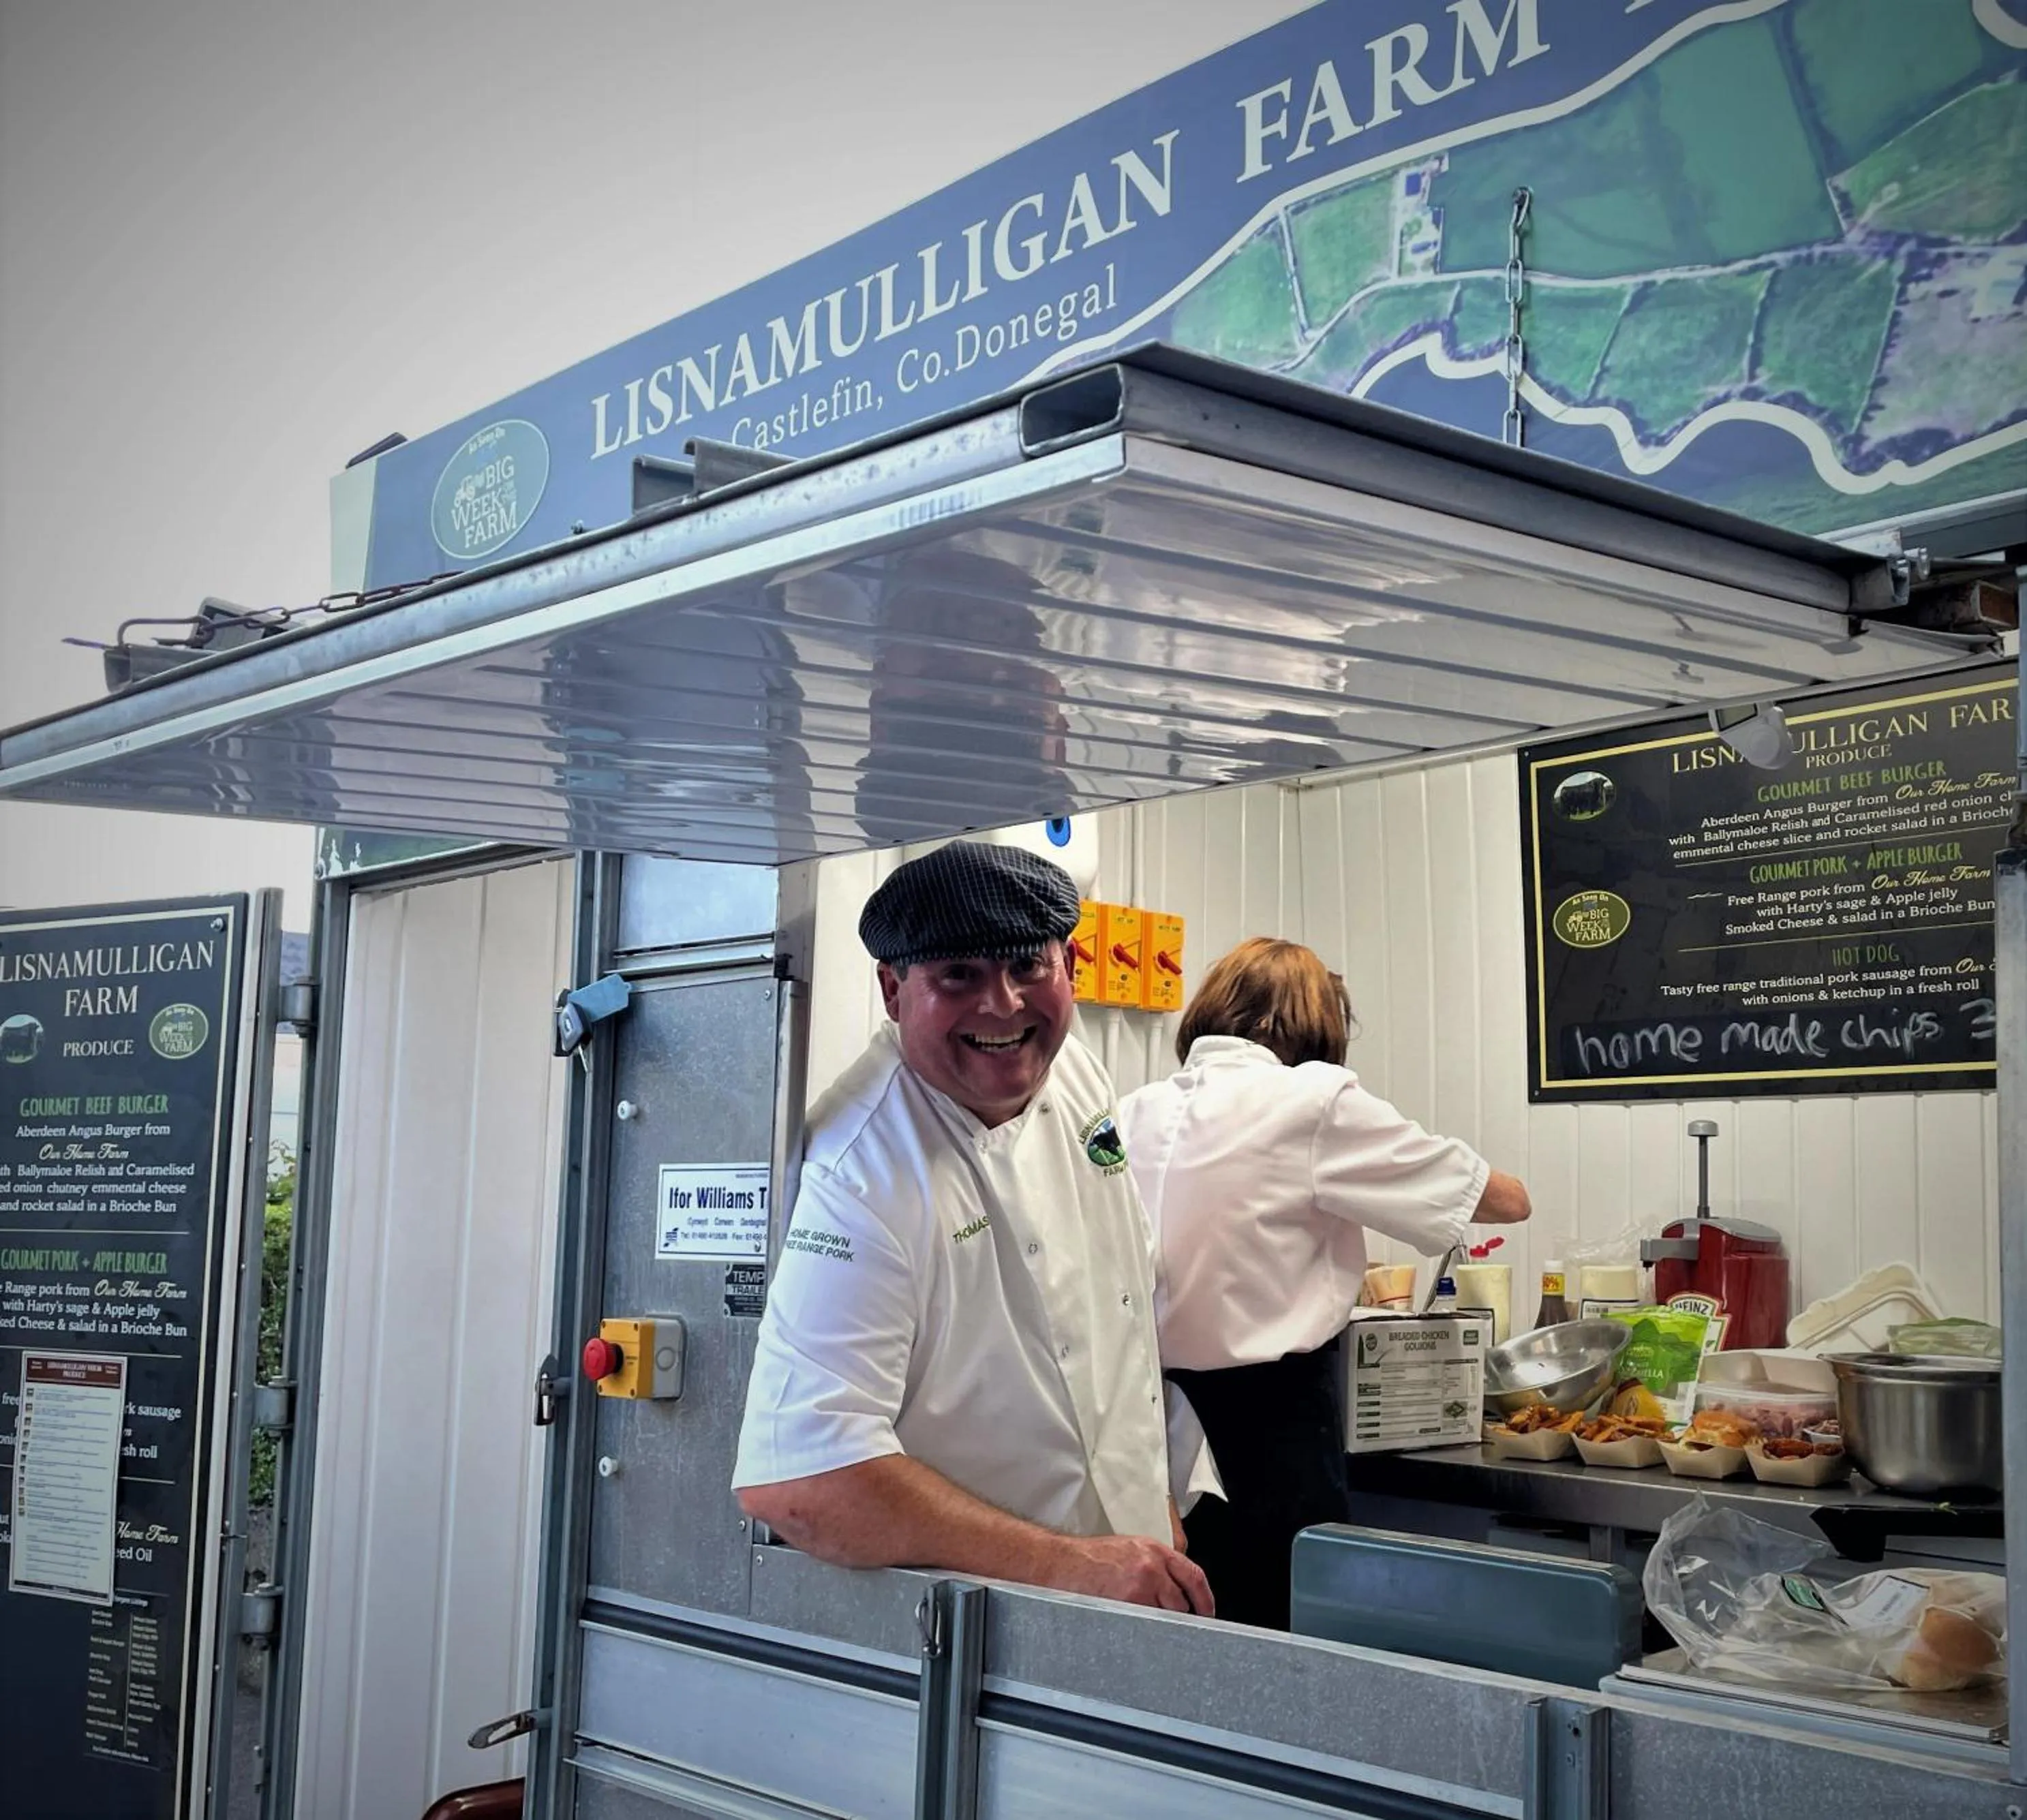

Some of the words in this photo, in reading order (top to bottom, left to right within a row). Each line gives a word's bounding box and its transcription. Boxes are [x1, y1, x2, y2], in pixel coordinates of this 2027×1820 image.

[589, 129, 1180, 459] LISNAMULLIGAN
[1235, 0, 1551, 183] FARM
[732, 377, 883, 450] Castlefin,
[485, 455, 515, 489] BIG
[451, 488, 503, 531] WEEK
[465, 501, 517, 549] FARM
[1949, 698, 2015, 728] FAR
[1806, 743, 1892, 769] PRODUCE
[1758, 776, 1831, 803] GOURMET
[1840, 770, 1874, 790] BEEF
[1881, 760, 1947, 784] BURGER
[1701, 812, 1760, 828] Aberdeen
[1763, 805, 1803, 820] Angus
[1808, 799, 1853, 813] Burger
[1857, 794, 1889, 807] from
[1895, 784, 1925, 800] Our
[1928, 778, 1970, 796] Home
[1975, 772, 2016, 788] Farm
[1668, 833, 1696, 846] with
[1704, 824, 1769, 842] Ballymaloe
[1772, 818, 1809, 833] Relish
[1811, 815, 1831, 827] and
[1834, 802, 1920, 824] Caramelised
[1924, 799, 1948, 812] red
[1951, 795, 1992, 809] onion
[1673, 842, 1735, 859] emmental
[1737, 837, 1780, 851] cheese
[1783, 831, 1812, 846] slice
[1816, 828, 1841, 841] and
[1844, 822, 1887, 837] rocket
[1891, 817, 1927, 831] salad
[1932, 815, 1946, 827] in
[1949, 815, 1957, 824] a
[1750, 860, 1810, 884] GOURMET
[1814, 855, 1848, 876] PORK
[1867, 848, 1906, 870] APPLE
[1908, 842, 1963, 865] BURGER
[1728, 895, 1754, 906] Free
[1758, 890, 1796, 904] Range
[1801, 886, 1831, 900] pork
[1833, 883, 1865, 895] from
[1872, 874, 1899, 890] Our
[1904, 869, 1945, 886] Home
[1949, 865, 1991, 882] Farm
[1589, 907, 1609, 919] BIG
[1756, 905, 1783, 917] with
[1787, 900, 1833, 914] Harty's
[1836, 898, 1866, 910] sage
[1870, 895, 1881, 906] &
[1886, 891, 1925, 906] Apple
[1929, 887, 1957, 902] jelly
[1566, 921, 1600, 933] WEEK
[1726, 921, 1774, 935] Smoked
[1778, 916, 1823, 929] Cheese
[1827, 914, 1838, 925] &
[1842, 910, 1877, 924] salad
[1881, 910, 1893, 919] in
[1898, 910, 1906, 919] a
[1910, 903, 1963, 917] Brioche
[1967, 899, 1996, 912] Bun
[1575, 927, 1611, 941] FARM
[0, 940, 215, 983] LISNAMULLIGAN
[1866, 944, 1900, 963] DOG
[1660, 985, 1694, 997] Tasty
[1696, 983, 1720, 993] free
[1722, 981, 1756, 992] range
[1759, 974, 1824, 988] traditional
[1828, 972, 1859, 985] pork
[1862, 966, 1915, 981] sausage
[1919, 965, 1952, 976] from
[1955, 957, 1985, 974] Our
[64, 985, 138, 1017] FARM
[1742, 994, 1769, 1006] with
[1772, 991, 1814, 1004] onions
[1818, 990, 1829, 1000] &
[1833, 986, 1885, 1000] ketchup
[1889, 985, 1902, 996] in
[1906, 986, 1915, 994] a
[1919, 981, 1952, 993] fresh
[1956, 978, 1979, 991] roll
[63, 1039, 134, 1057] PRODUCE
[1575, 1022, 1703, 1074] home
[1721, 1013, 1830, 1058] made
[1840, 1008, 1944, 1060] chips
[20, 1097, 80, 1117] GOURMET
[86, 1096, 113, 1115] BEEF
[118, 1094, 169, 1114] BURGER
[16, 1125, 65, 1137] Aberdeen
[68, 1125, 102, 1139] Angus
[105, 1124, 142, 1138] Burger
[144, 1123, 170, 1135] from
[18, 1164, 72, 1179] Ballymaloe
[75, 1164, 106, 1176] Relish
[108, 1164, 123, 1176] and
[126, 1163, 195, 1176] Caramelised
[13, 1182, 42, 1193] onion
[47, 1182, 89, 1197] chutney
[91, 1181, 146, 1193] emmental
[148, 1182, 187, 1194] cheese
[669, 1187, 692, 1209] Ifor
[697, 1187, 755, 1209] Williams
[0, 1200, 18, 1211] and
[22, 1199, 54, 1212] rocket
[57, 1199, 83, 1212] salad
[87, 1200, 97, 1212] in
[100, 1203, 106, 1212] a
[109, 1200, 151, 1212] Brioche
[155, 1200, 177, 1213] Bun
[810, 1231, 851, 1248] GROWN
[953, 1216, 990, 1244] THOMAS
[1, 1248, 50, 1270] GOURMET
[52, 1250, 78, 1271] PORK
[93, 1251, 123, 1273] APPLE
[125, 1252, 167, 1274] BURGER
[825, 1246, 855, 1262] PORK
[5, 1281, 36, 1297] Range
[39, 1282, 63, 1297] pork
[65, 1284, 90, 1296] from
[3, 1299, 25, 1312] with
[27, 1300, 63, 1314] Harty's
[66, 1304, 89, 1316] sage
[92, 1303, 101, 1315] &
[104, 1303, 136, 1318] Apple
[137, 1304, 160, 1320] jelly
[18, 1316, 55, 1330] Cheese
[58, 1318, 66, 1330] &
[68, 1318, 95, 1332] salad
[98, 1320, 109, 1332] in
[111, 1325, 118, 1333] a
[121, 1321, 162, 1335] Brioche
[166, 1324, 187, 1336] Bun
[138, 1406, 181, 1421] sausage
[139, 1445, 157, 1458] roll
[136, 1547, 152, 1562] Oil
